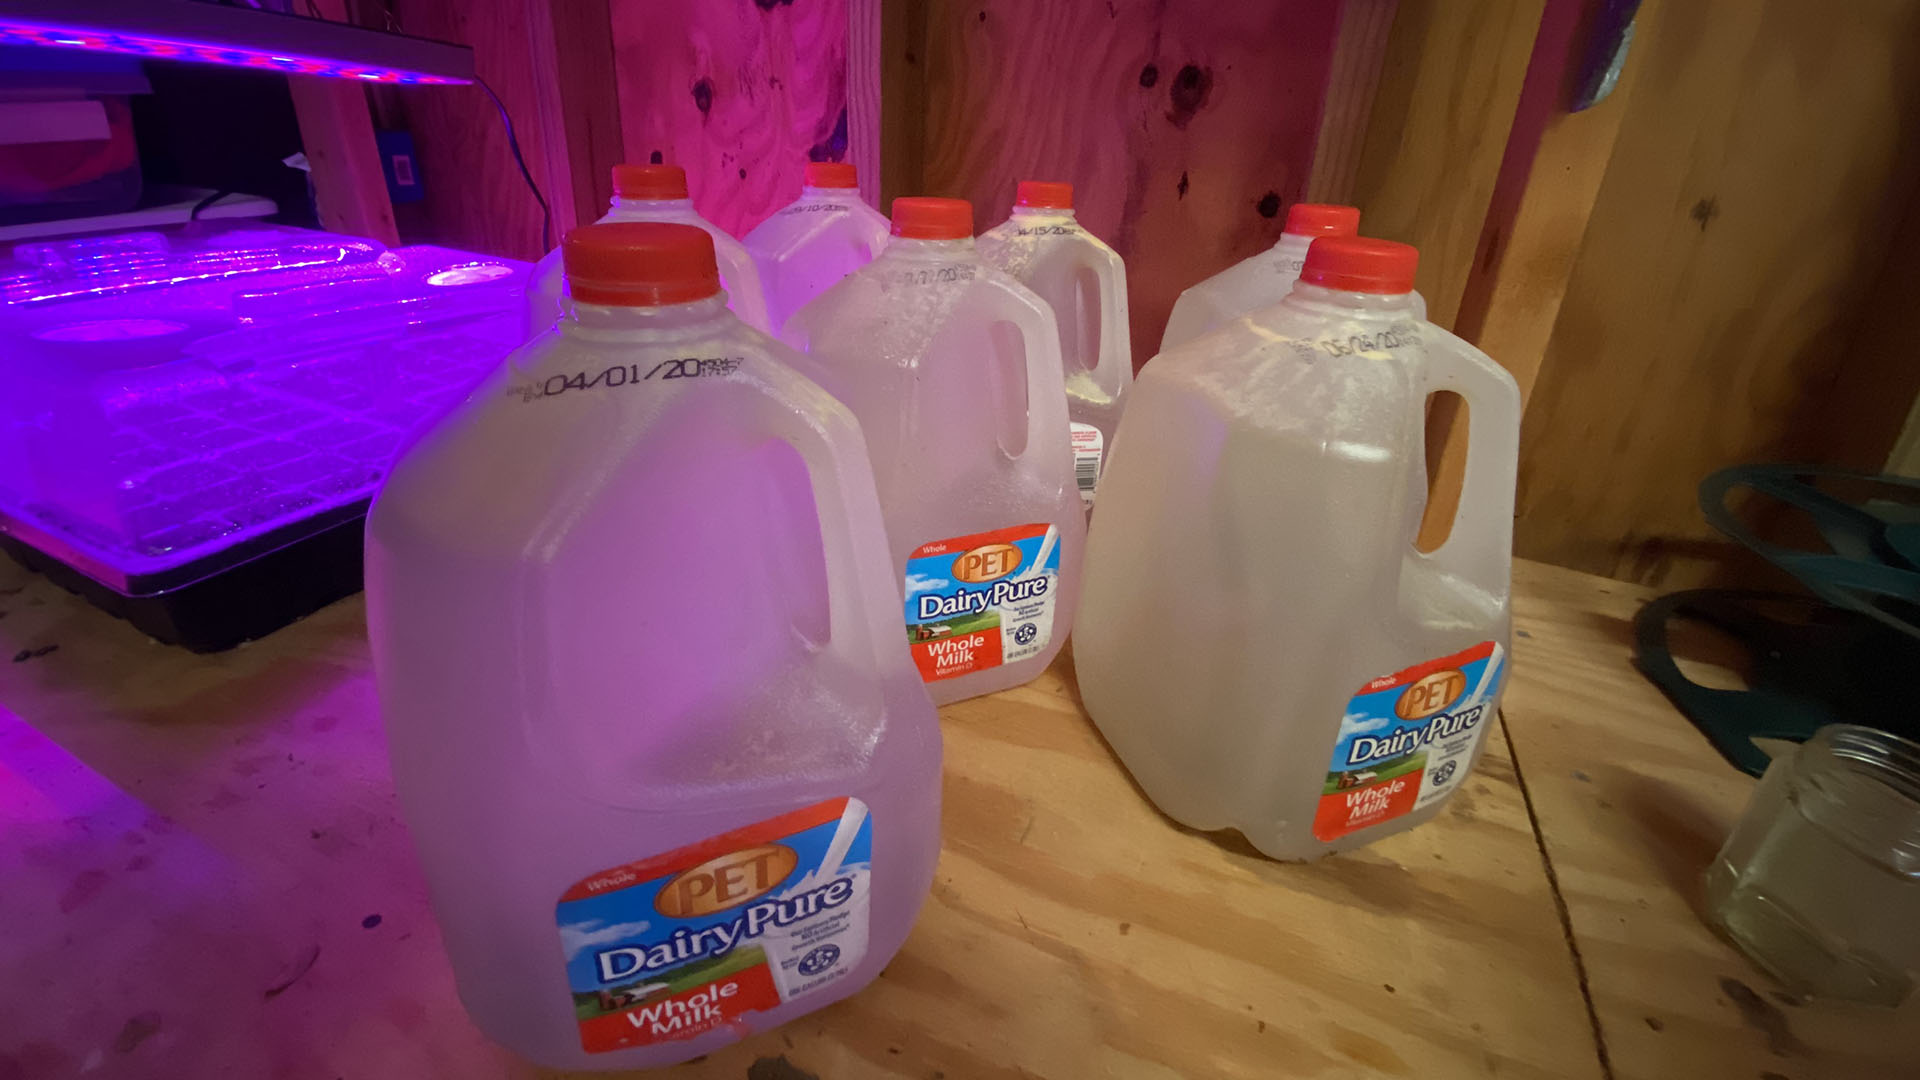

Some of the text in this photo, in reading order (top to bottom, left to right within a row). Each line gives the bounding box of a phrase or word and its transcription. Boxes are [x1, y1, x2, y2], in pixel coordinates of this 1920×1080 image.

[544, 357, 701, 396] 04/01/20
[922, 544, 947, 555] Whole
[963, 549, 1014, 580] PET
[919, 576, 1049, 620] DairyPure
[927, 634, 985, 657] Whole
[936, 650, 975, 669] Milk
[1371, 676, 1397, 690] Whole
[1403, 675, 1460, 717] PET
[1348, 706, 1482, 766] DairyPure
[1346, 779, 1406, 809] Whole
[1348, 797, 1389, 821] Milk
[587, 871, 637, 892] Whole
[675, 851, 780, 916] PET
[598, 876, 854, 982] DairyPure
[626, 982, 739, 1029] Whole
[651, 1003, 722, 1036] Milk
